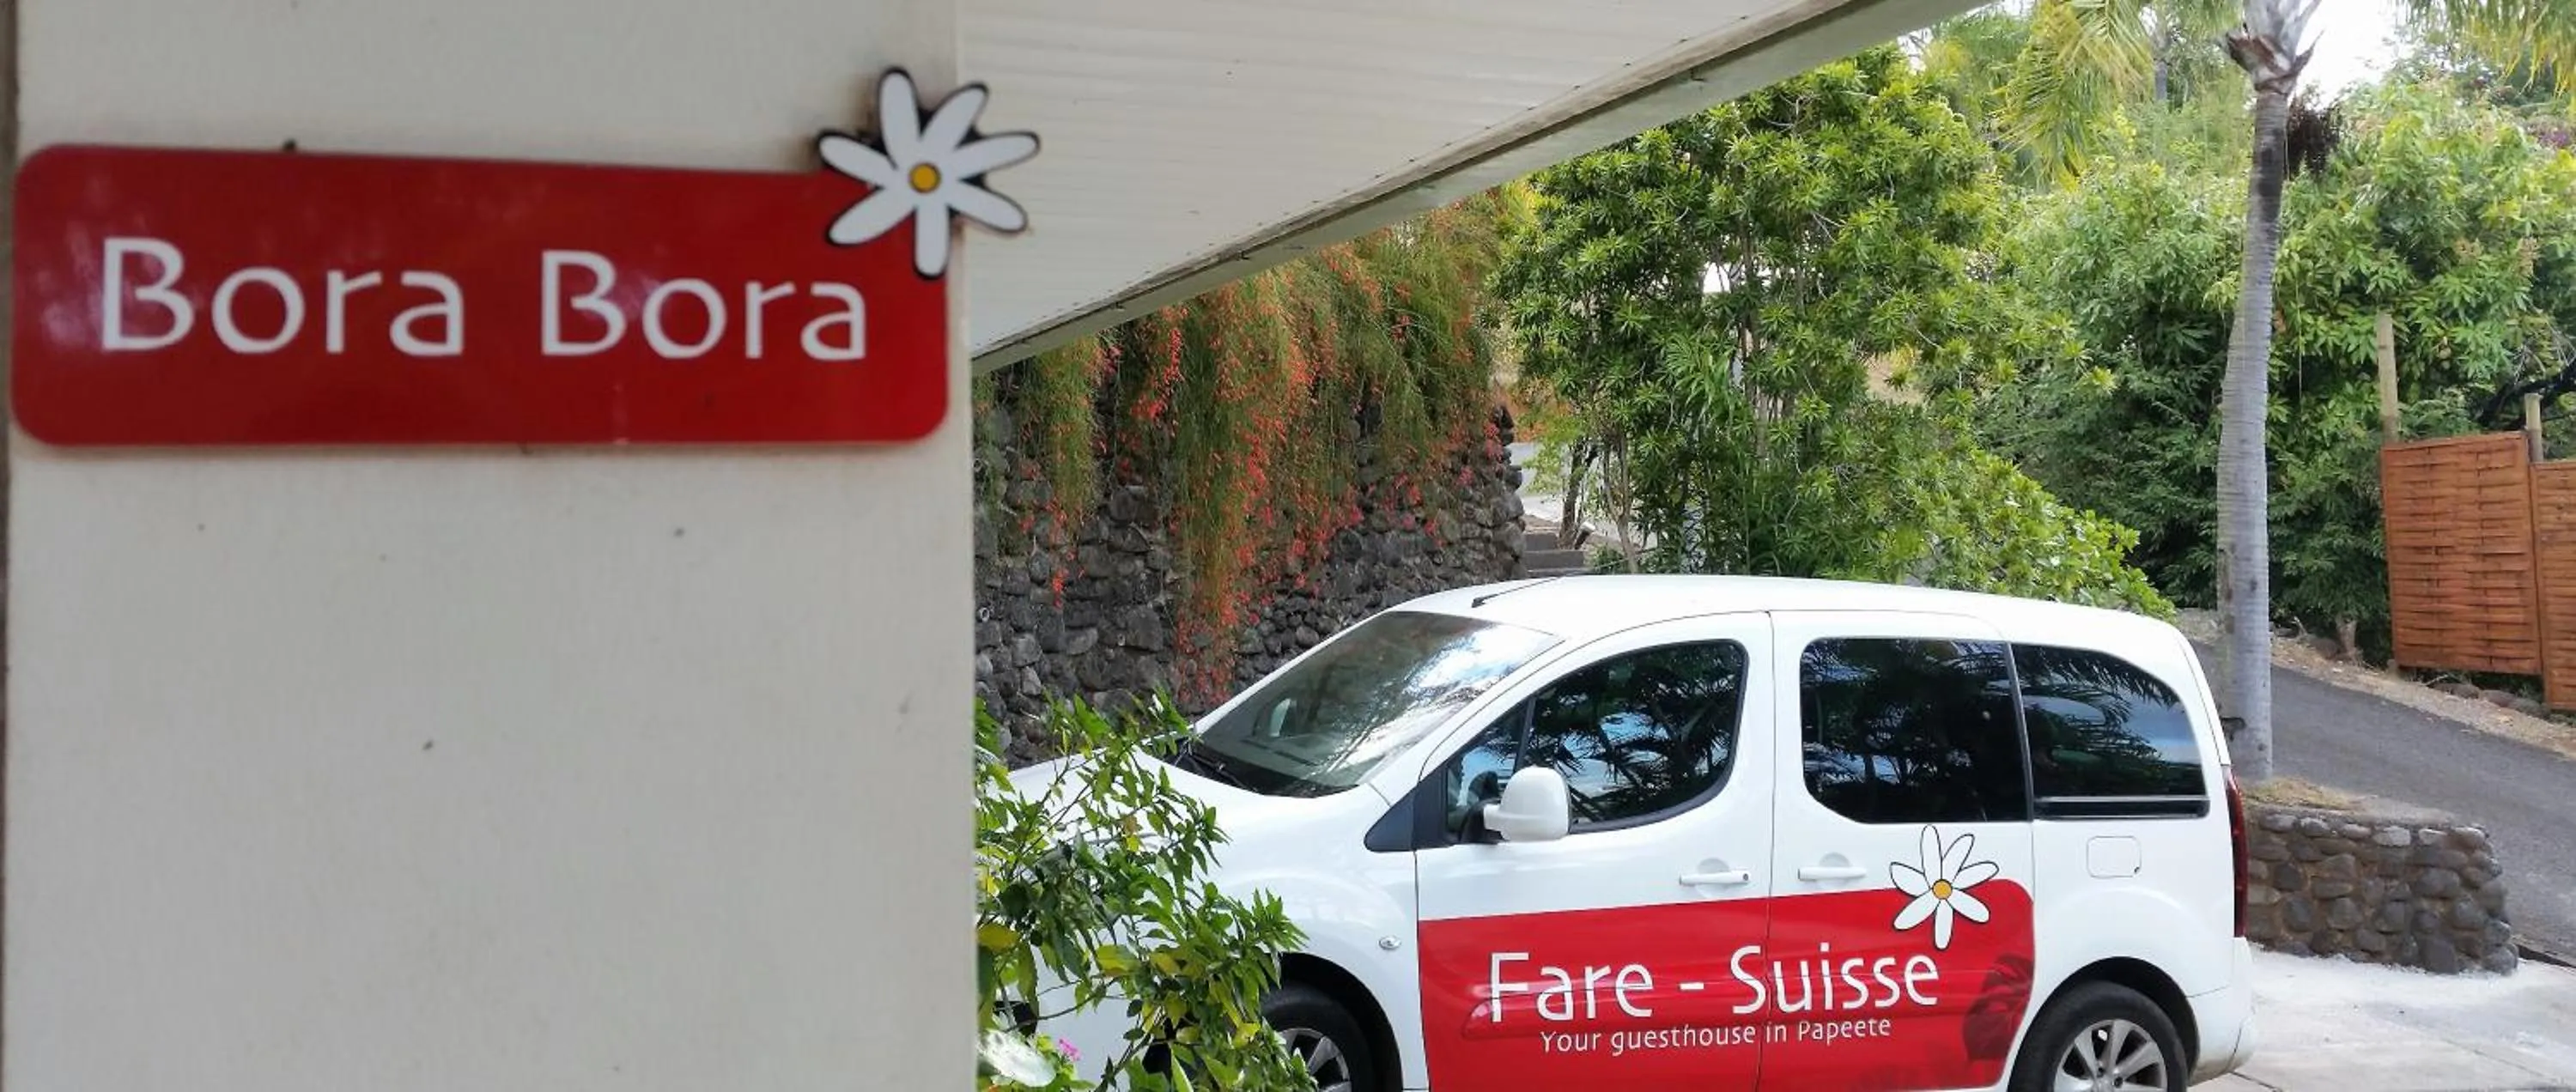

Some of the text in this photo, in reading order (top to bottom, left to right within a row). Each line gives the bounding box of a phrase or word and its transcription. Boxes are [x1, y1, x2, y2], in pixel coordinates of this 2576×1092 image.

[101, 236, 868, 361] Bora Bora
[1490, 951, 1654, 1023] Fare
[1731, 942, 1941, 1015] Suisse
[1540, 1017, 1892, 1057] Your guesthouse in Papeete
